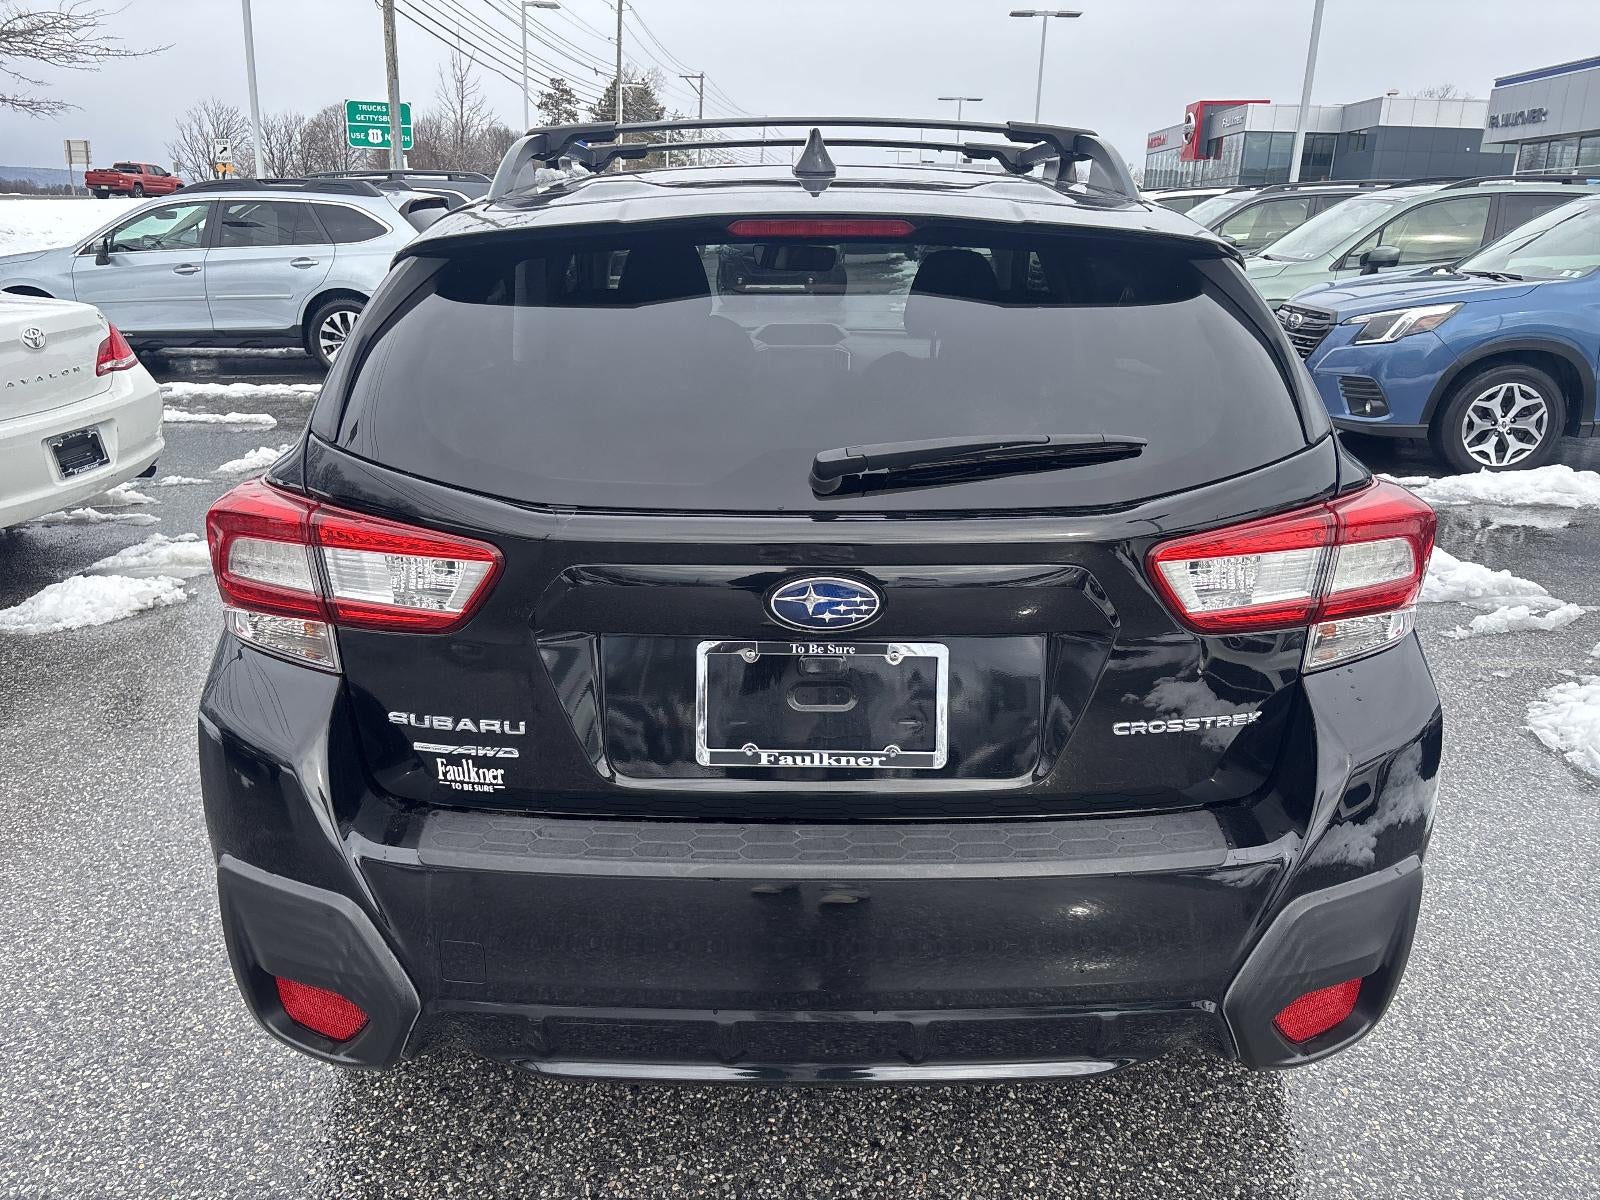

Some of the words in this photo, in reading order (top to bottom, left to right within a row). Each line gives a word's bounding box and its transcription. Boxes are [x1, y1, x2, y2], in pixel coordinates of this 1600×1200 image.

[358, 104, 386, 112] TRUCKS
[356, 114, 402, 122] GETTYSB
[384, 133, 410, 142] NTH
[4, 366, 81, 392] AVALON
[789, 643, 805, 654] To
[808, 643, 825, 654] Be
[827, 643, 856, 655] Sure
[387, 711, 527, 735] SUBARU
[1112, 711, 1263, 736] CROSSTREK
[757, 752, 886, 768] Faulkner
[436, 757, 505, 784] Faulkner
[450, 782, 463, 790] TO
[463, 783, 474, 791] BE
[475, 784, 495, 793] SURE
